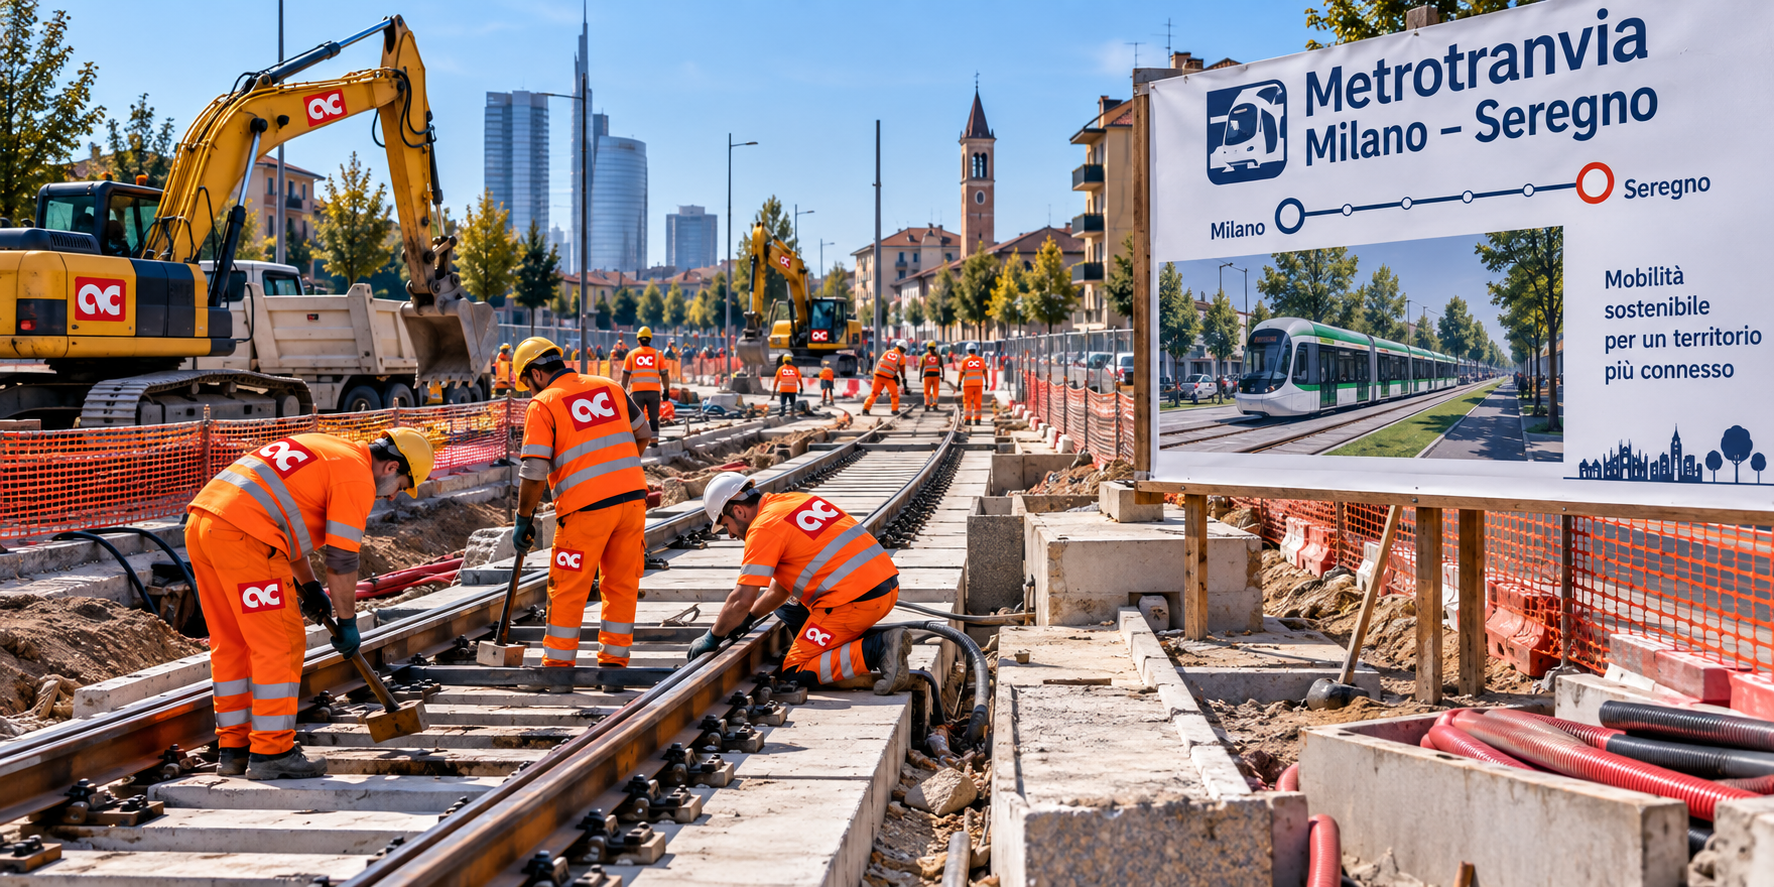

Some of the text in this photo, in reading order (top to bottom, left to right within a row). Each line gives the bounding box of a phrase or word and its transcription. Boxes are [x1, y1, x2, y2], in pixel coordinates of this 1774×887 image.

[1306, 8, 1649, 117] Metrotranvia
[1306, 120, 1428, 167] Milano
[1475, 87, 1659, 142] Seregno
[1624, 177, 1711, 201] Seregno
[1211, 221, 1266, 240] Milano
[1605, 265, 1685, 290] Mobilità
[1605, 295, 1711, 320] sostenibile
[1605, 325, 1763, 355] per un territorio
[1605, 360, 1735, 386] più connesso
